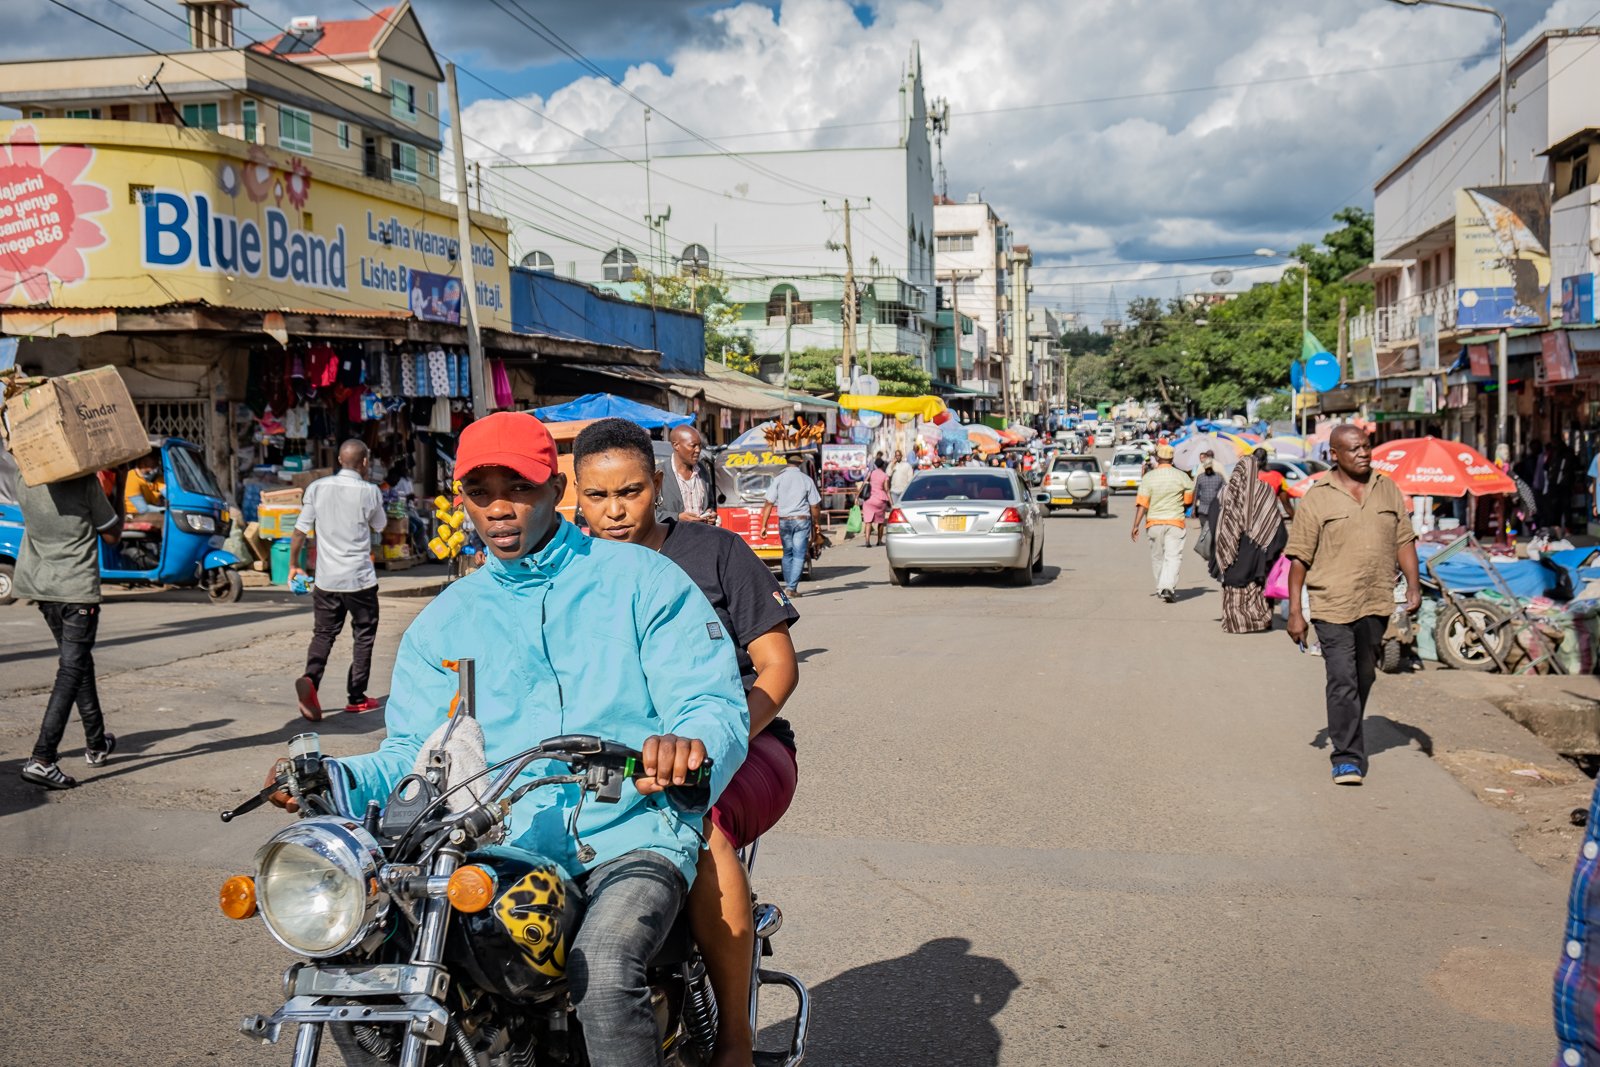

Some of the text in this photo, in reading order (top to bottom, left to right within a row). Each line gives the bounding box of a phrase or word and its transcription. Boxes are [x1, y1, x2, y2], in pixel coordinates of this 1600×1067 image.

[0, 173, 44, 201] ajarini
[14, 193, 58, 218] yenye
[40, 211, 60, 226] na
[367, 211, 495, 267] Ladha wanayoenda
[360, 256, 397, 289] Lishe
